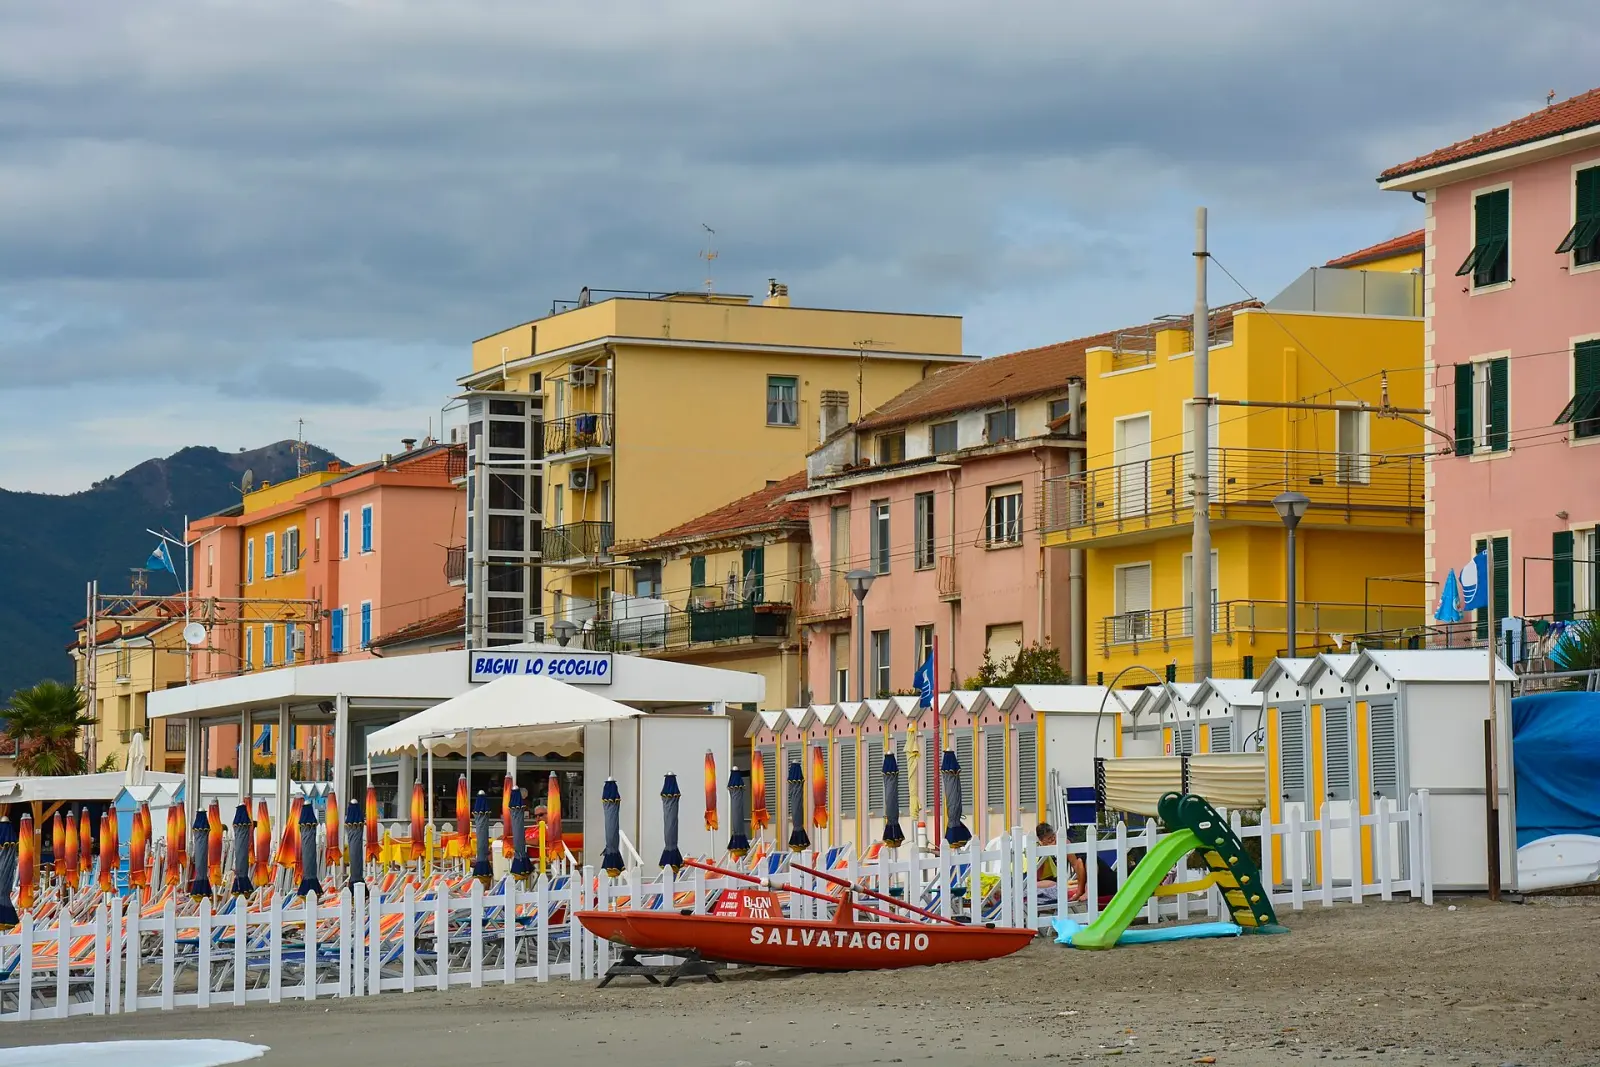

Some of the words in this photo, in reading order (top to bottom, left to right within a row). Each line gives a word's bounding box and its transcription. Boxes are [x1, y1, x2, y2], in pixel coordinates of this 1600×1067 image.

[475, 657, 519, 674] BAGNI
[525, 658, 544, 675] LO
[548, 659, 608, 676] SCOGLIO
[743, 895, 772, 909] BAGNI
[749, 907, 770, 919] ZITA
[750, 926, 930, 951] SALVATAGGIO
